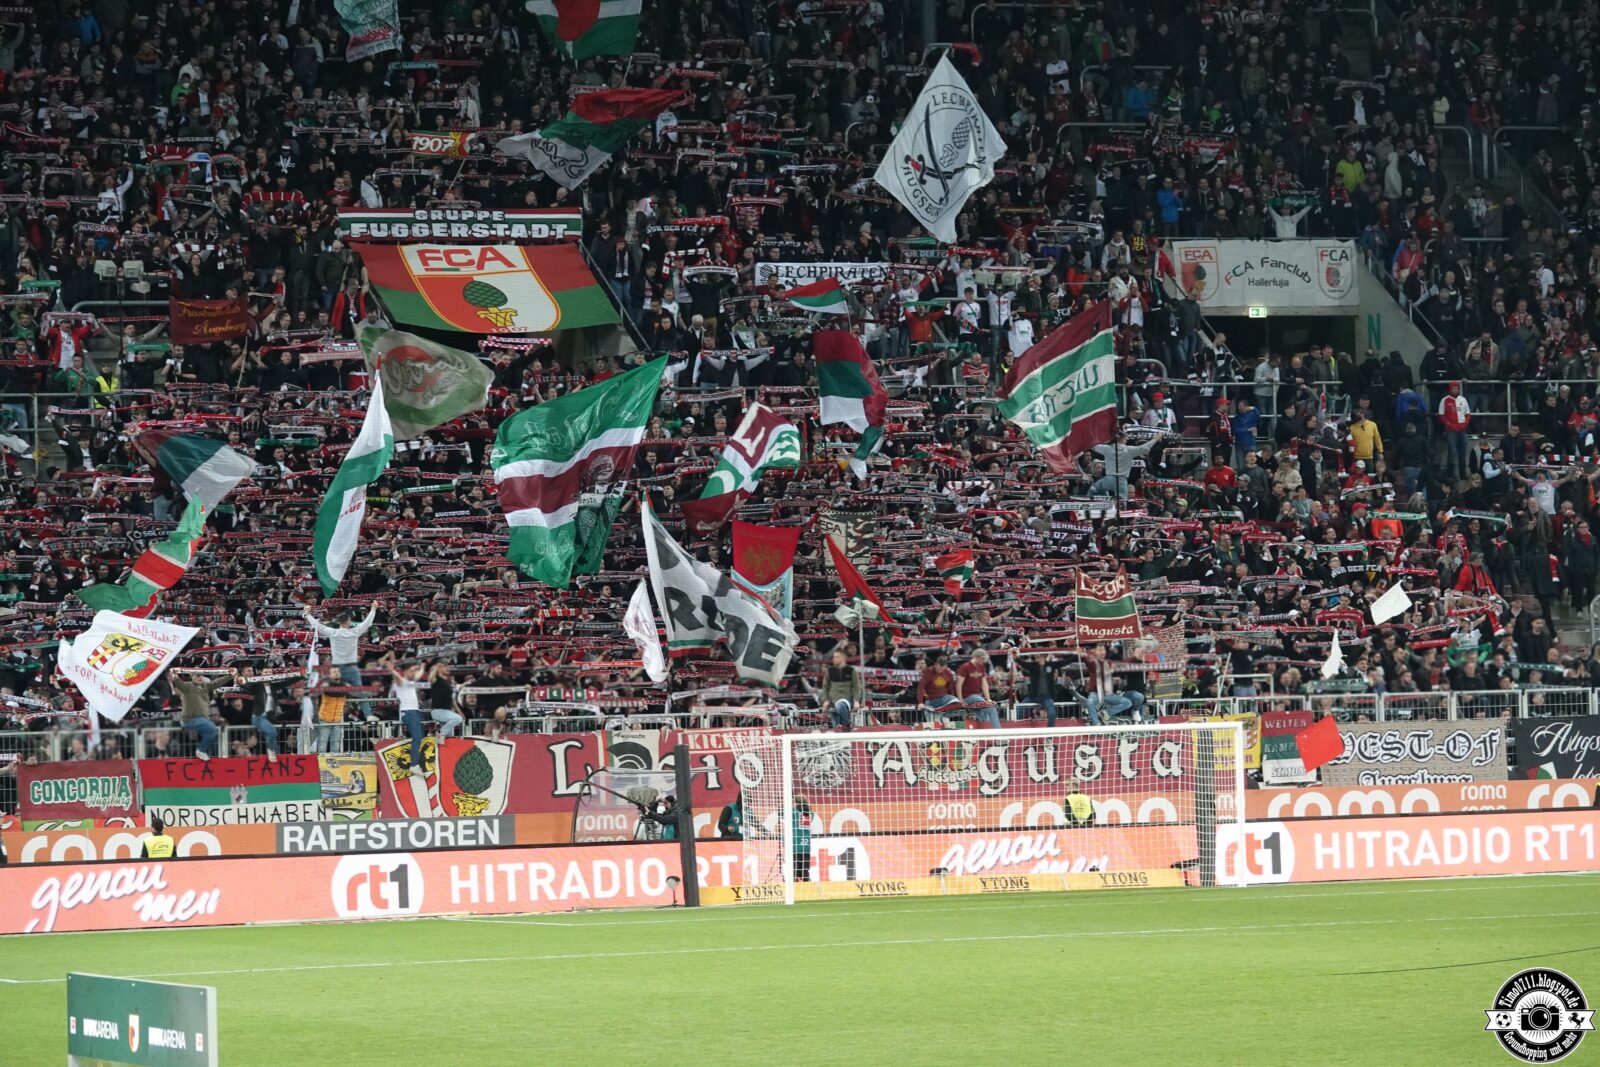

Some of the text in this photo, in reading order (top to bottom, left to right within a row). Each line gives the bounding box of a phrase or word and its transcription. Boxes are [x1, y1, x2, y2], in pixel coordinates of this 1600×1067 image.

[411, 136, 453, 153] 1907
[414, 210, 505, 222] GRUPPE
[350, 221, 569, 239] FUGGERSTADT
[417, 246, 517, 270] FCA
[1184, 249, 1214, 261] FCA
[1320, 250, 1349, 262] FCA
[775, 263, 890, 280] LECHPIRATEN
[1225, 256, 1312, 286] FCA Fanclub
[1367, 313, 1381, 351] N
[1331, 566, 1347, 578] NUR
[1348, 565, 1363, 573] DER
[1366, 564, 1382, 573] FCA
[1078, 623, 1135, 638] Augusta
[1264, 718, 1307, 729] WELTEN
[166, 761, 214, 782] FCA
[246, 757, 307, 777] FANS
[30, 776, 131, 805] CONCORDIA
[1461, 784, 1507, 800] roma
[150, 802, 326, 828] NORDSCHWABEN
[927, 802, 977, 820] roma
[576, 814, 627, 831] roma
[283, 819, 500, 852] RAFFSTOREN
[800, 838, 810, 846] 22
[1314, 823, 1595, 870] HITRADIO RT1
[696, 853, 759, 888] RT1
[1100, 872, 1148, 885] YTONG
[346, 863, 410, 912] rt1
[450, 857, 667, 904] HITRADIO
[856, 881, 908, 894] YTONG
[979, 876, 1030, 890] YTONG
[26, 864, 168, 933] genau
[731, 884, 784, 898] YTONG
